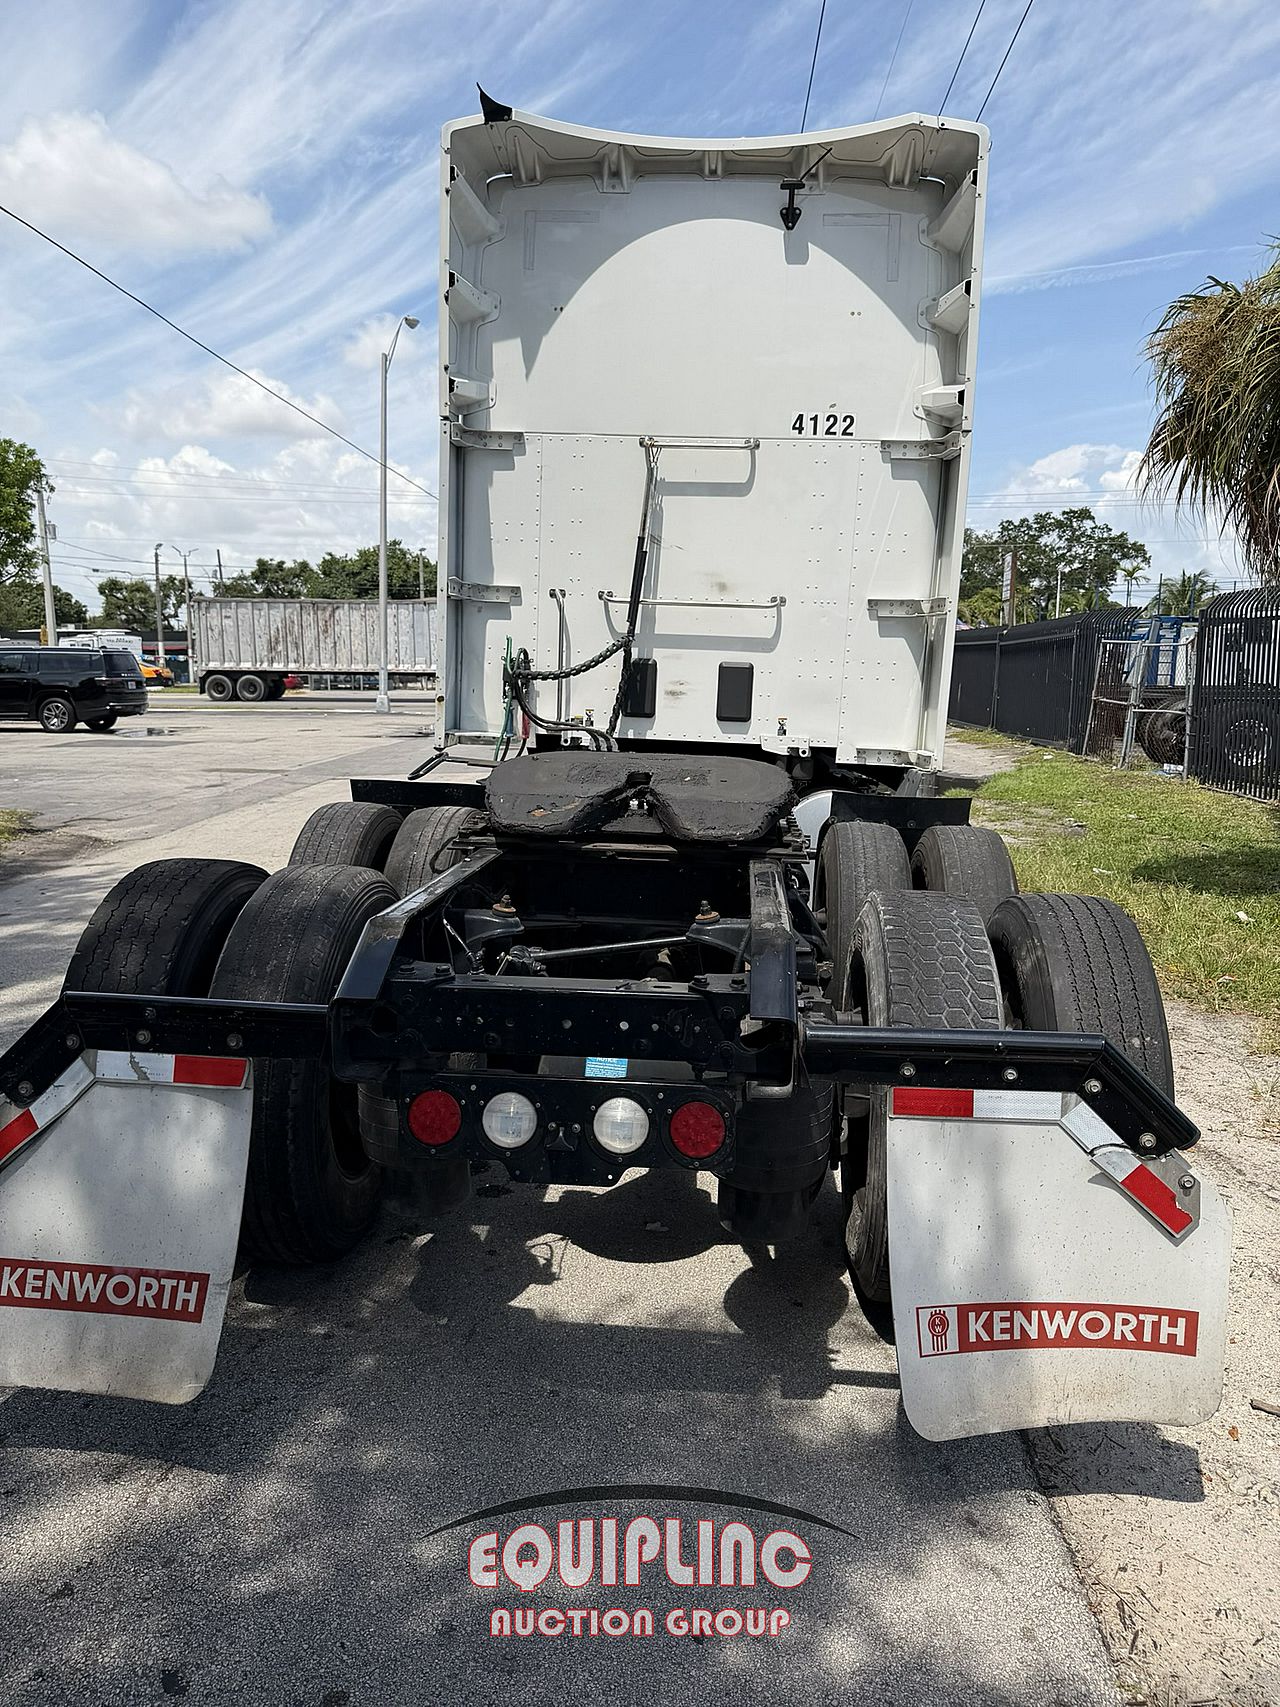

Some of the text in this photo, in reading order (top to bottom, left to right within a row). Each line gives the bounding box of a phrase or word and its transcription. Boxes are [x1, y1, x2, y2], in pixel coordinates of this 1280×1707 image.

[792, 413, 855, 437] 4122
[0, 1266, 199, 1313] KENWORTH
[968, 1310, 1186, 1346] KENWORTH
